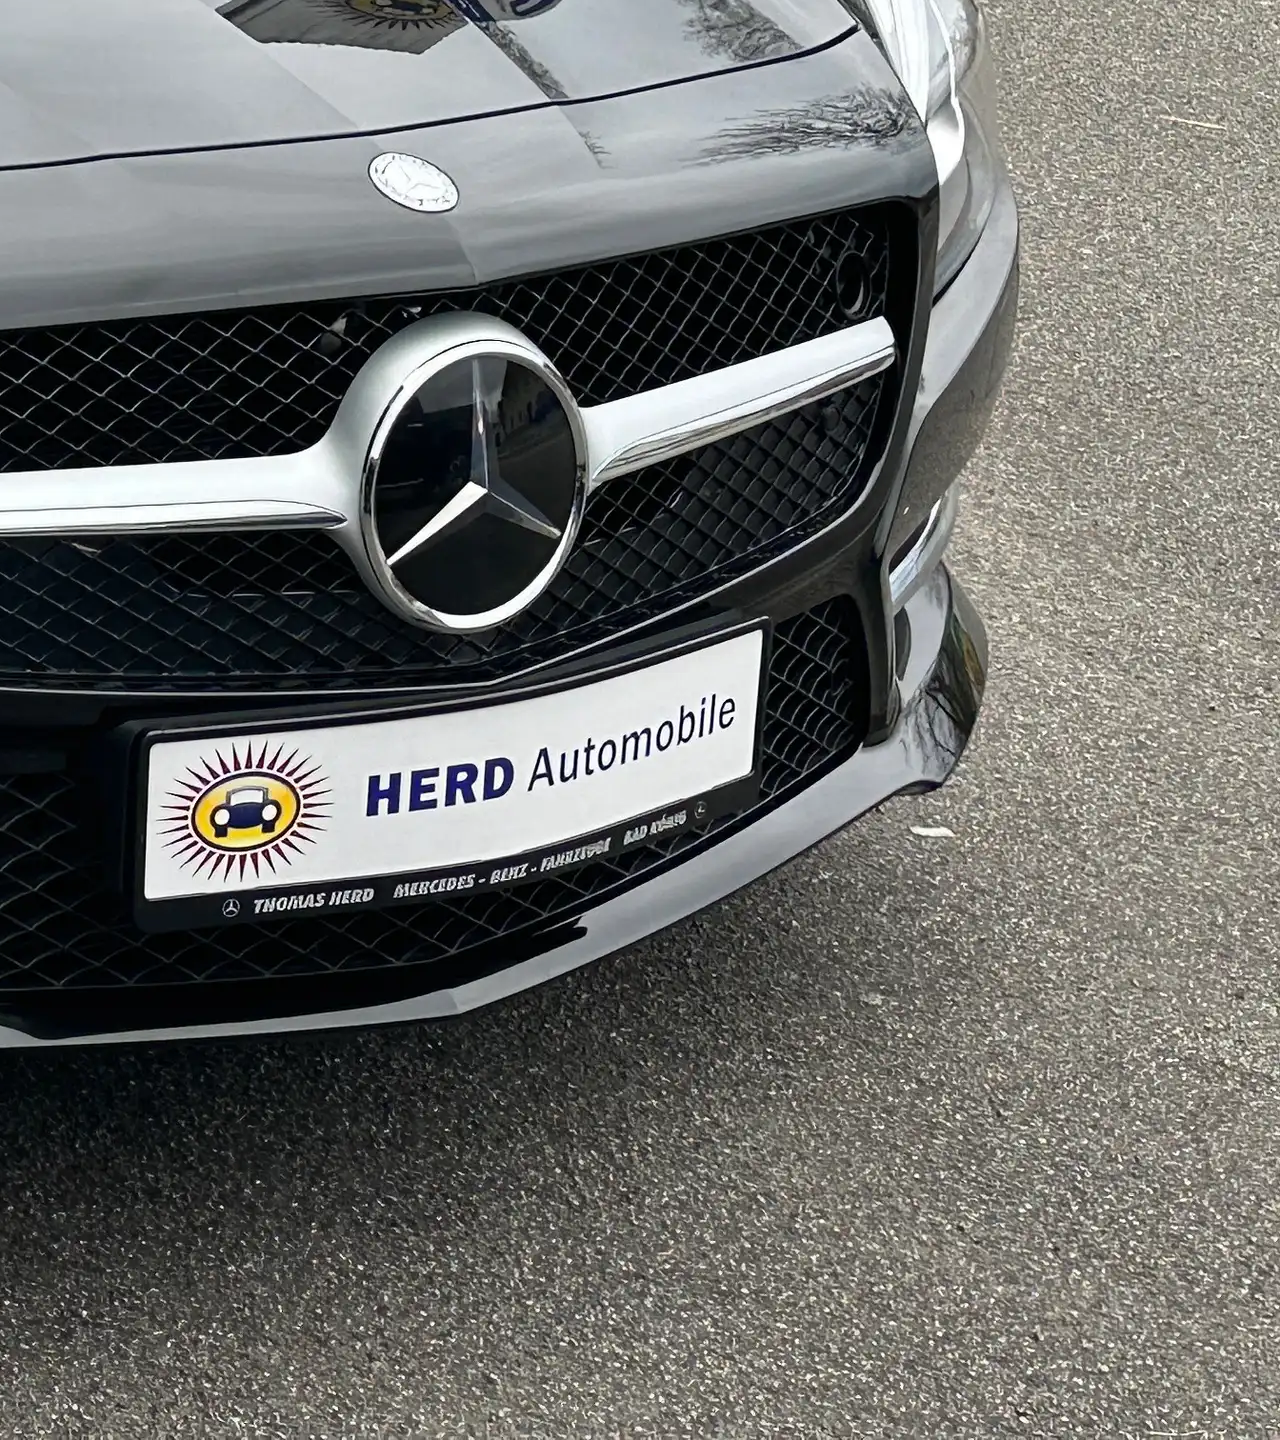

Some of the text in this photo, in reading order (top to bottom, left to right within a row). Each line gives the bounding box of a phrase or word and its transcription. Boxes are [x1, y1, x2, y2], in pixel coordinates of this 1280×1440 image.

[366, 693, 736, 817] HERD Automobile
[253, 892, 326, 915] THOMAS
[329, 888, 375, 907] HERD
[392, 873, 476, 899] MERCEDES
